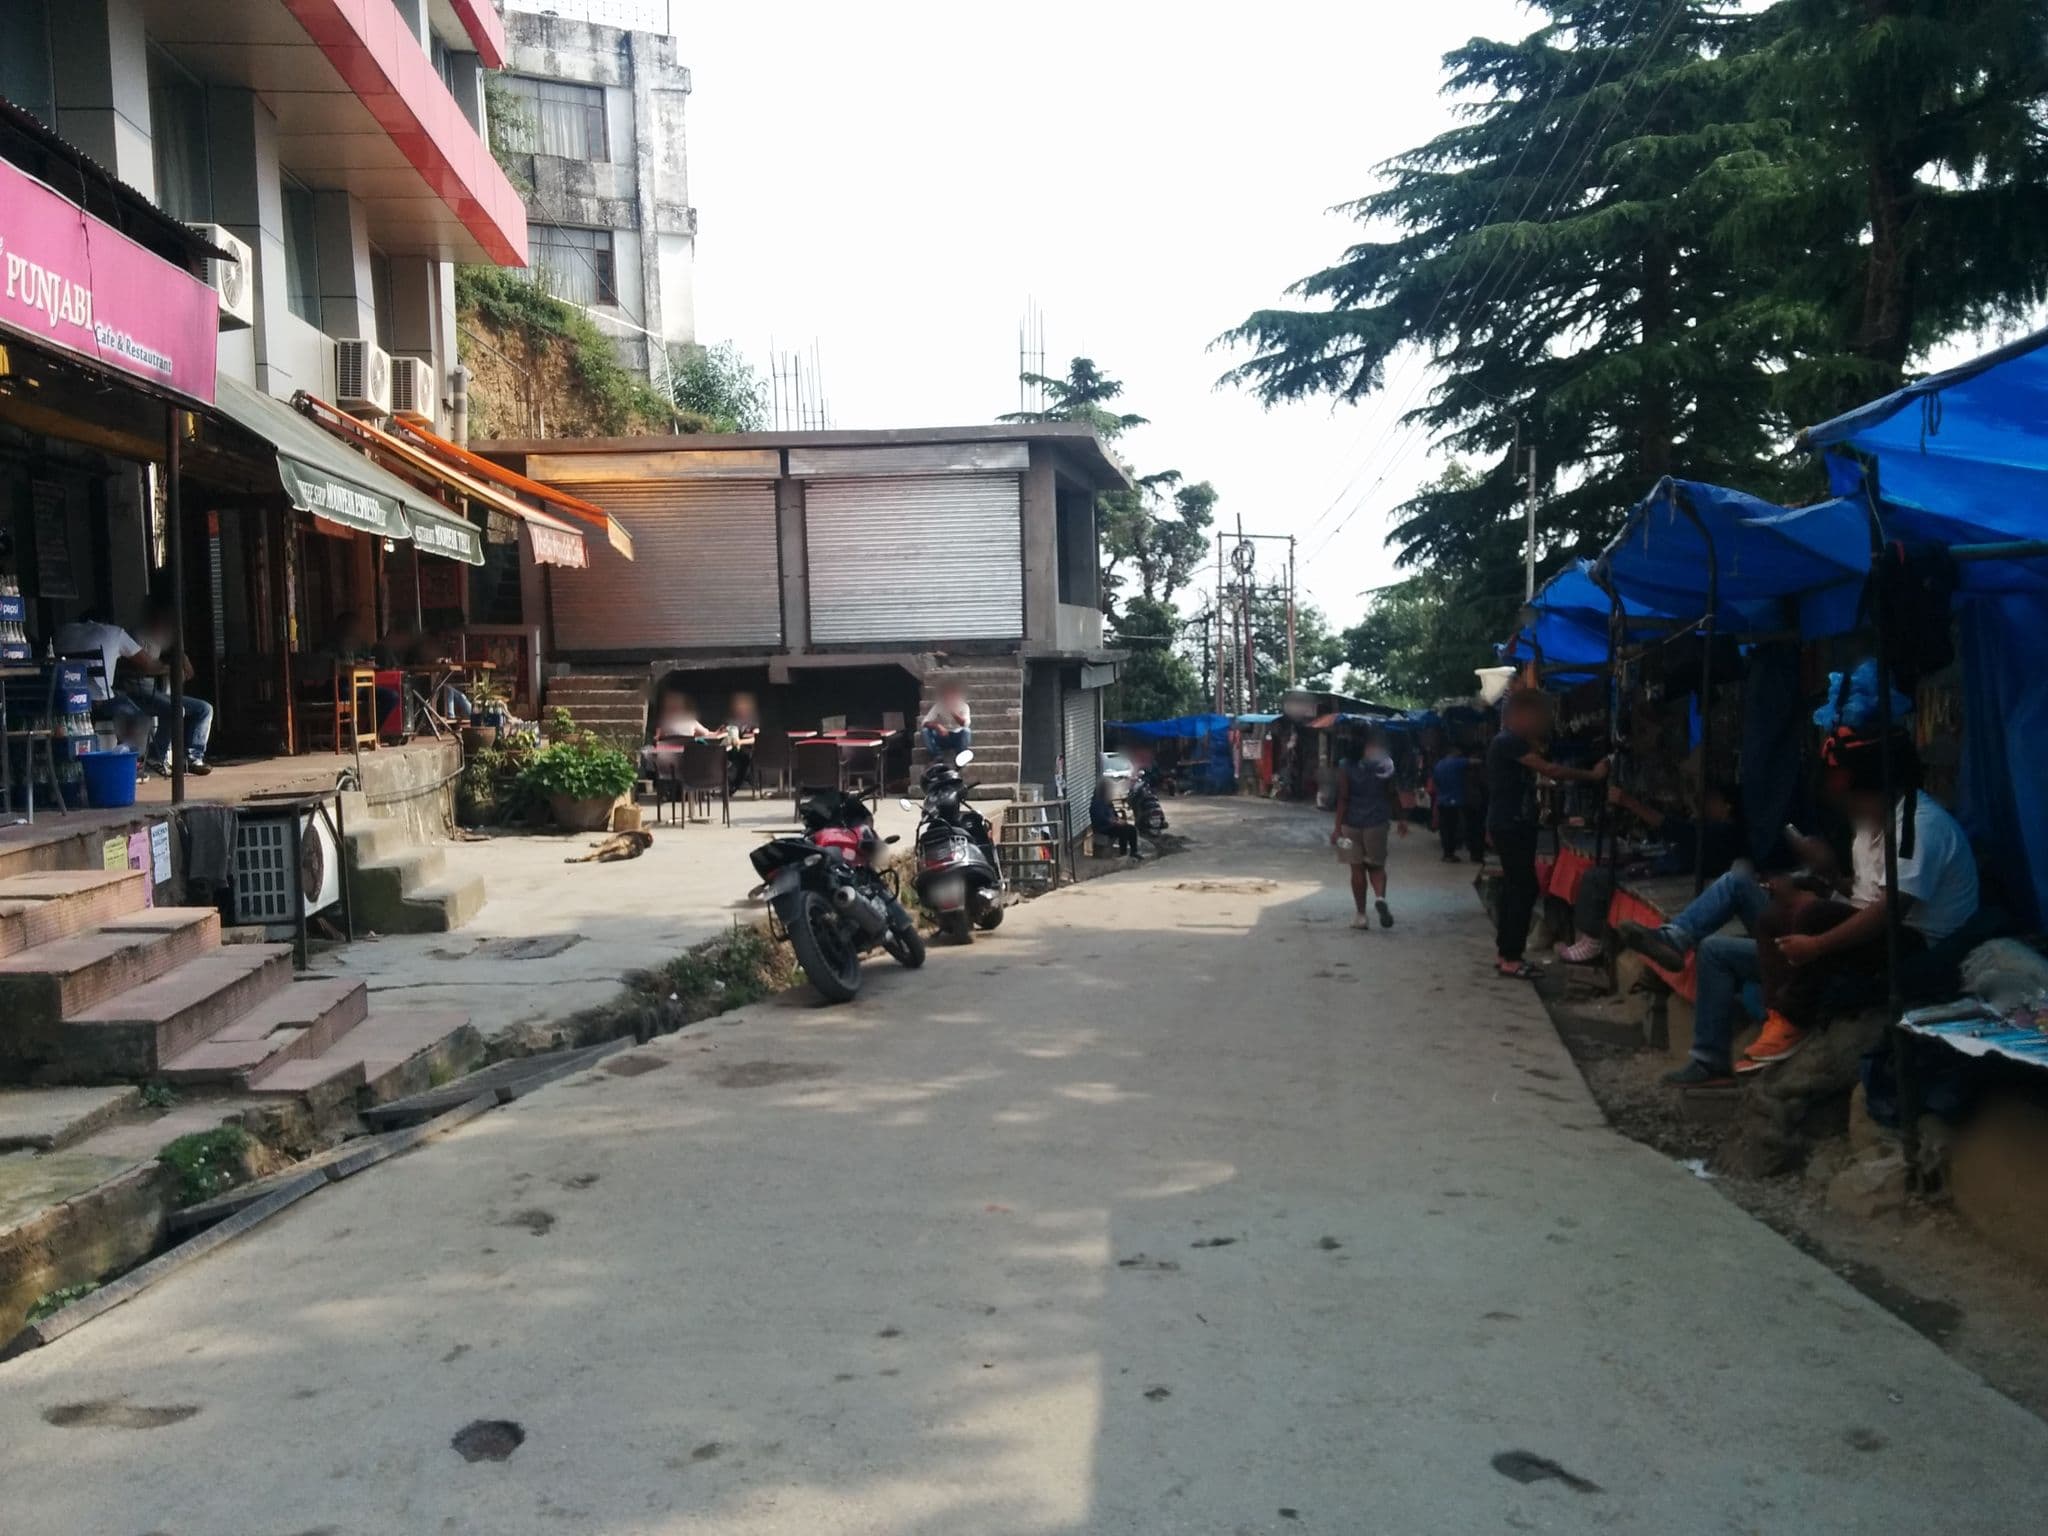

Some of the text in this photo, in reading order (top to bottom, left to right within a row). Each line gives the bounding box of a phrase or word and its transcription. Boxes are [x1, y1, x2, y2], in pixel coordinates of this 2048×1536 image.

[6, 252, 93, 330] PUNJABI
[95, 326, 116, 348] Cafe
[117, 335, 124, 352] &
[3, 603, 19, 616] pepsi
